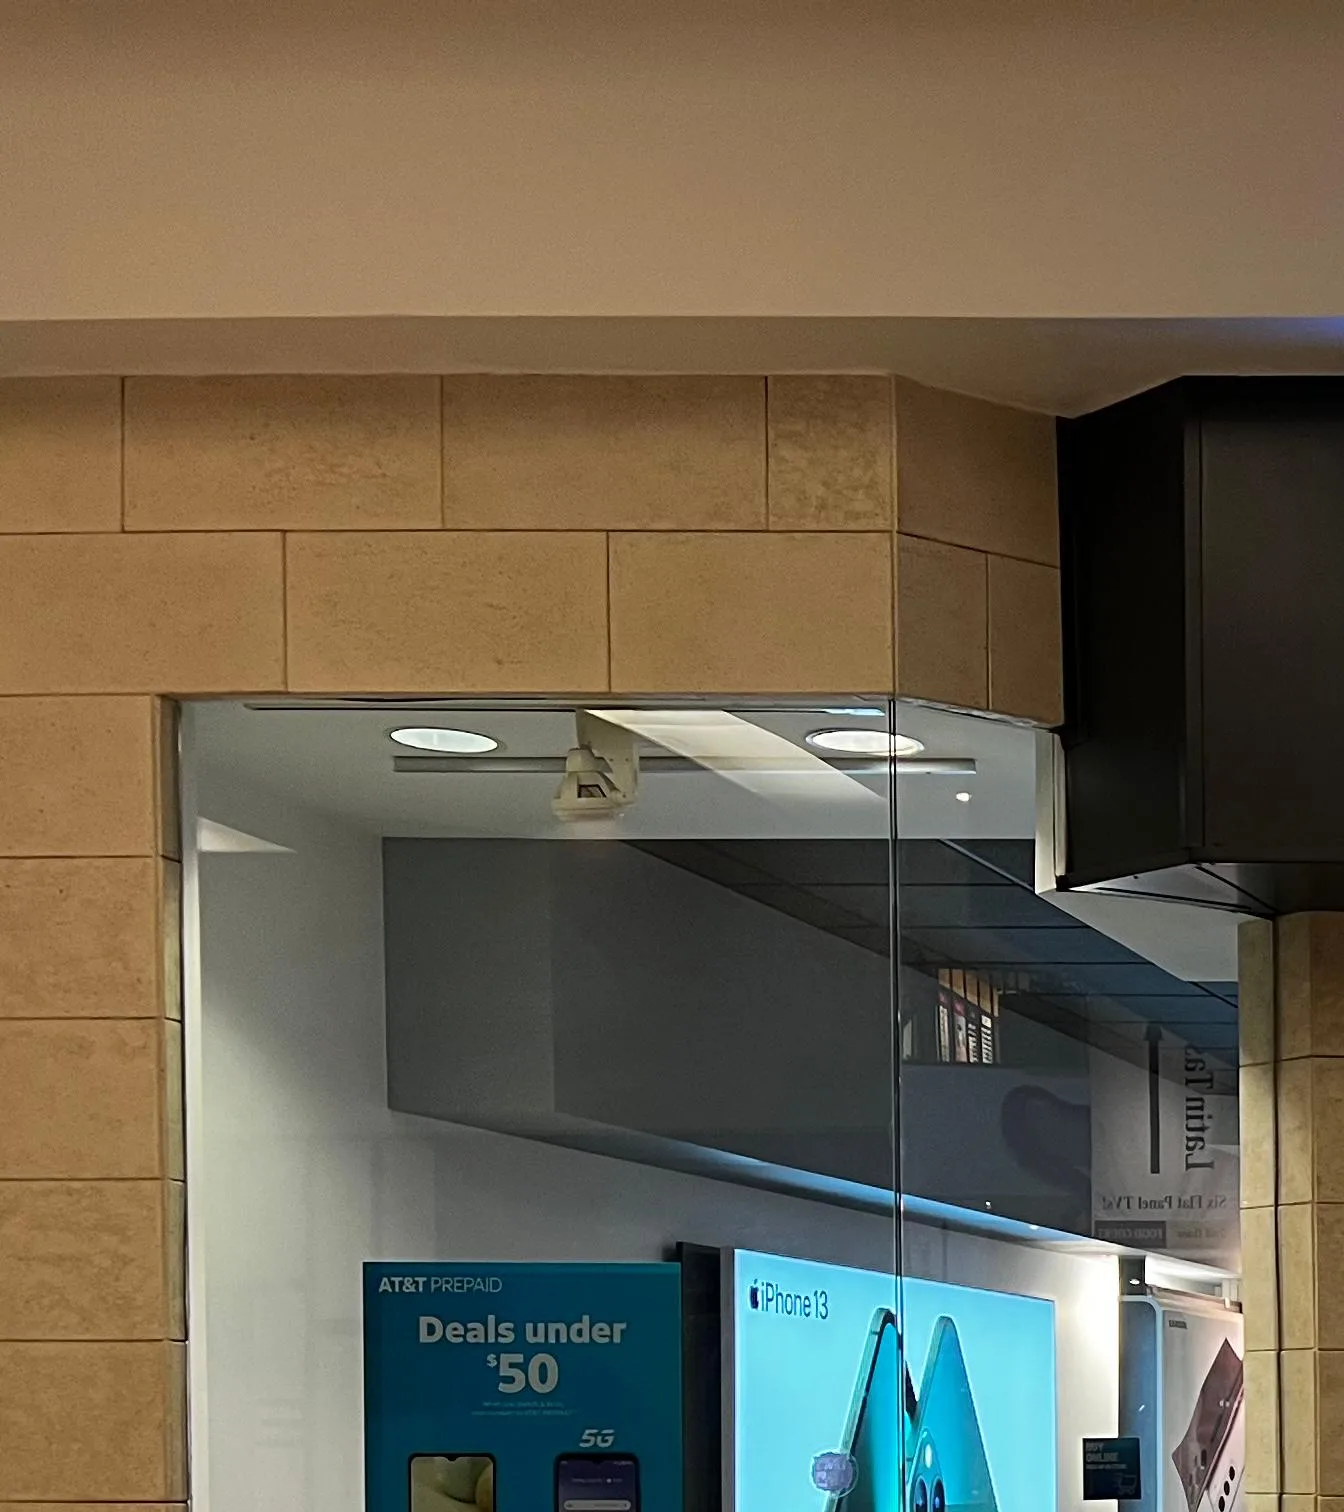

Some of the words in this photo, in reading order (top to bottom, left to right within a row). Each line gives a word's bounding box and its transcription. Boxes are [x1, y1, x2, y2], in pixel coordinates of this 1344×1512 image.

[378, 1276, 427, 1293] AT&T
[431, 1276, 502, 1293] PREPAID
[761, 1282, 811, 1318] iPhone
[813, 1290, 829, 1320] 13
[418, 1314, 515, 1344] Deals
[525, 1315, 627, 1344] under
[486, 1352, 559, 1394] $50
[579, 1429, 614, 1448] 5G
